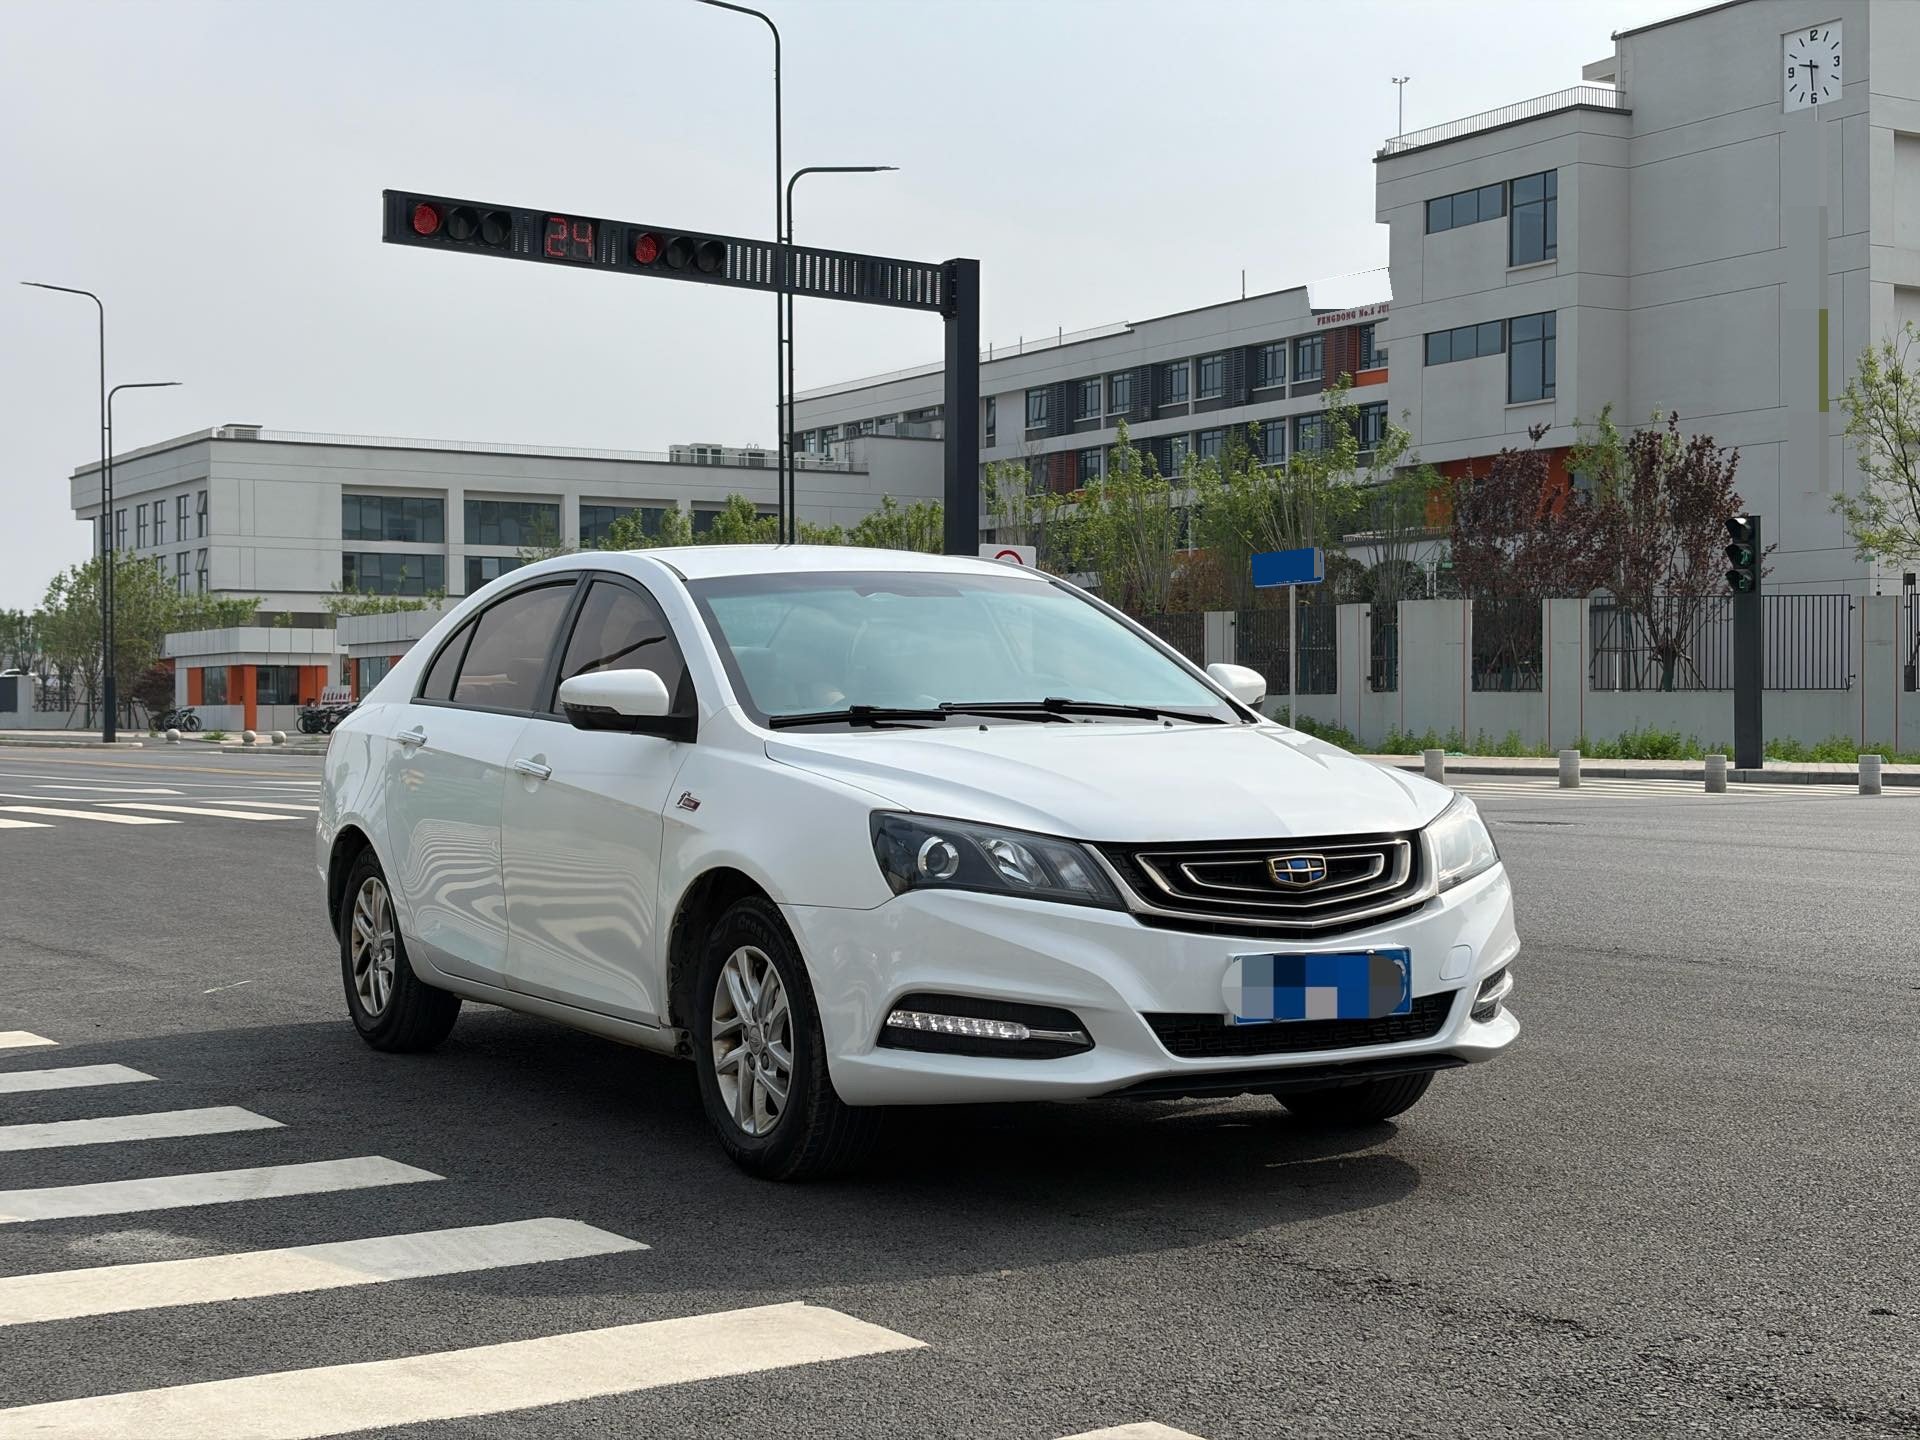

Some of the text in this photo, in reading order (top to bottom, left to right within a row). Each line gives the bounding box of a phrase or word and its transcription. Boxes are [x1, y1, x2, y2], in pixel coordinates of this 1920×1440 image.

[1810, 29, 1818, 42] 12
[1833, 55, 1840, 67] 3
[1788, 67, 1795, 79] 9
[1811, 92, 1817, 104] 6
[546, 217, 592, 257] 24
